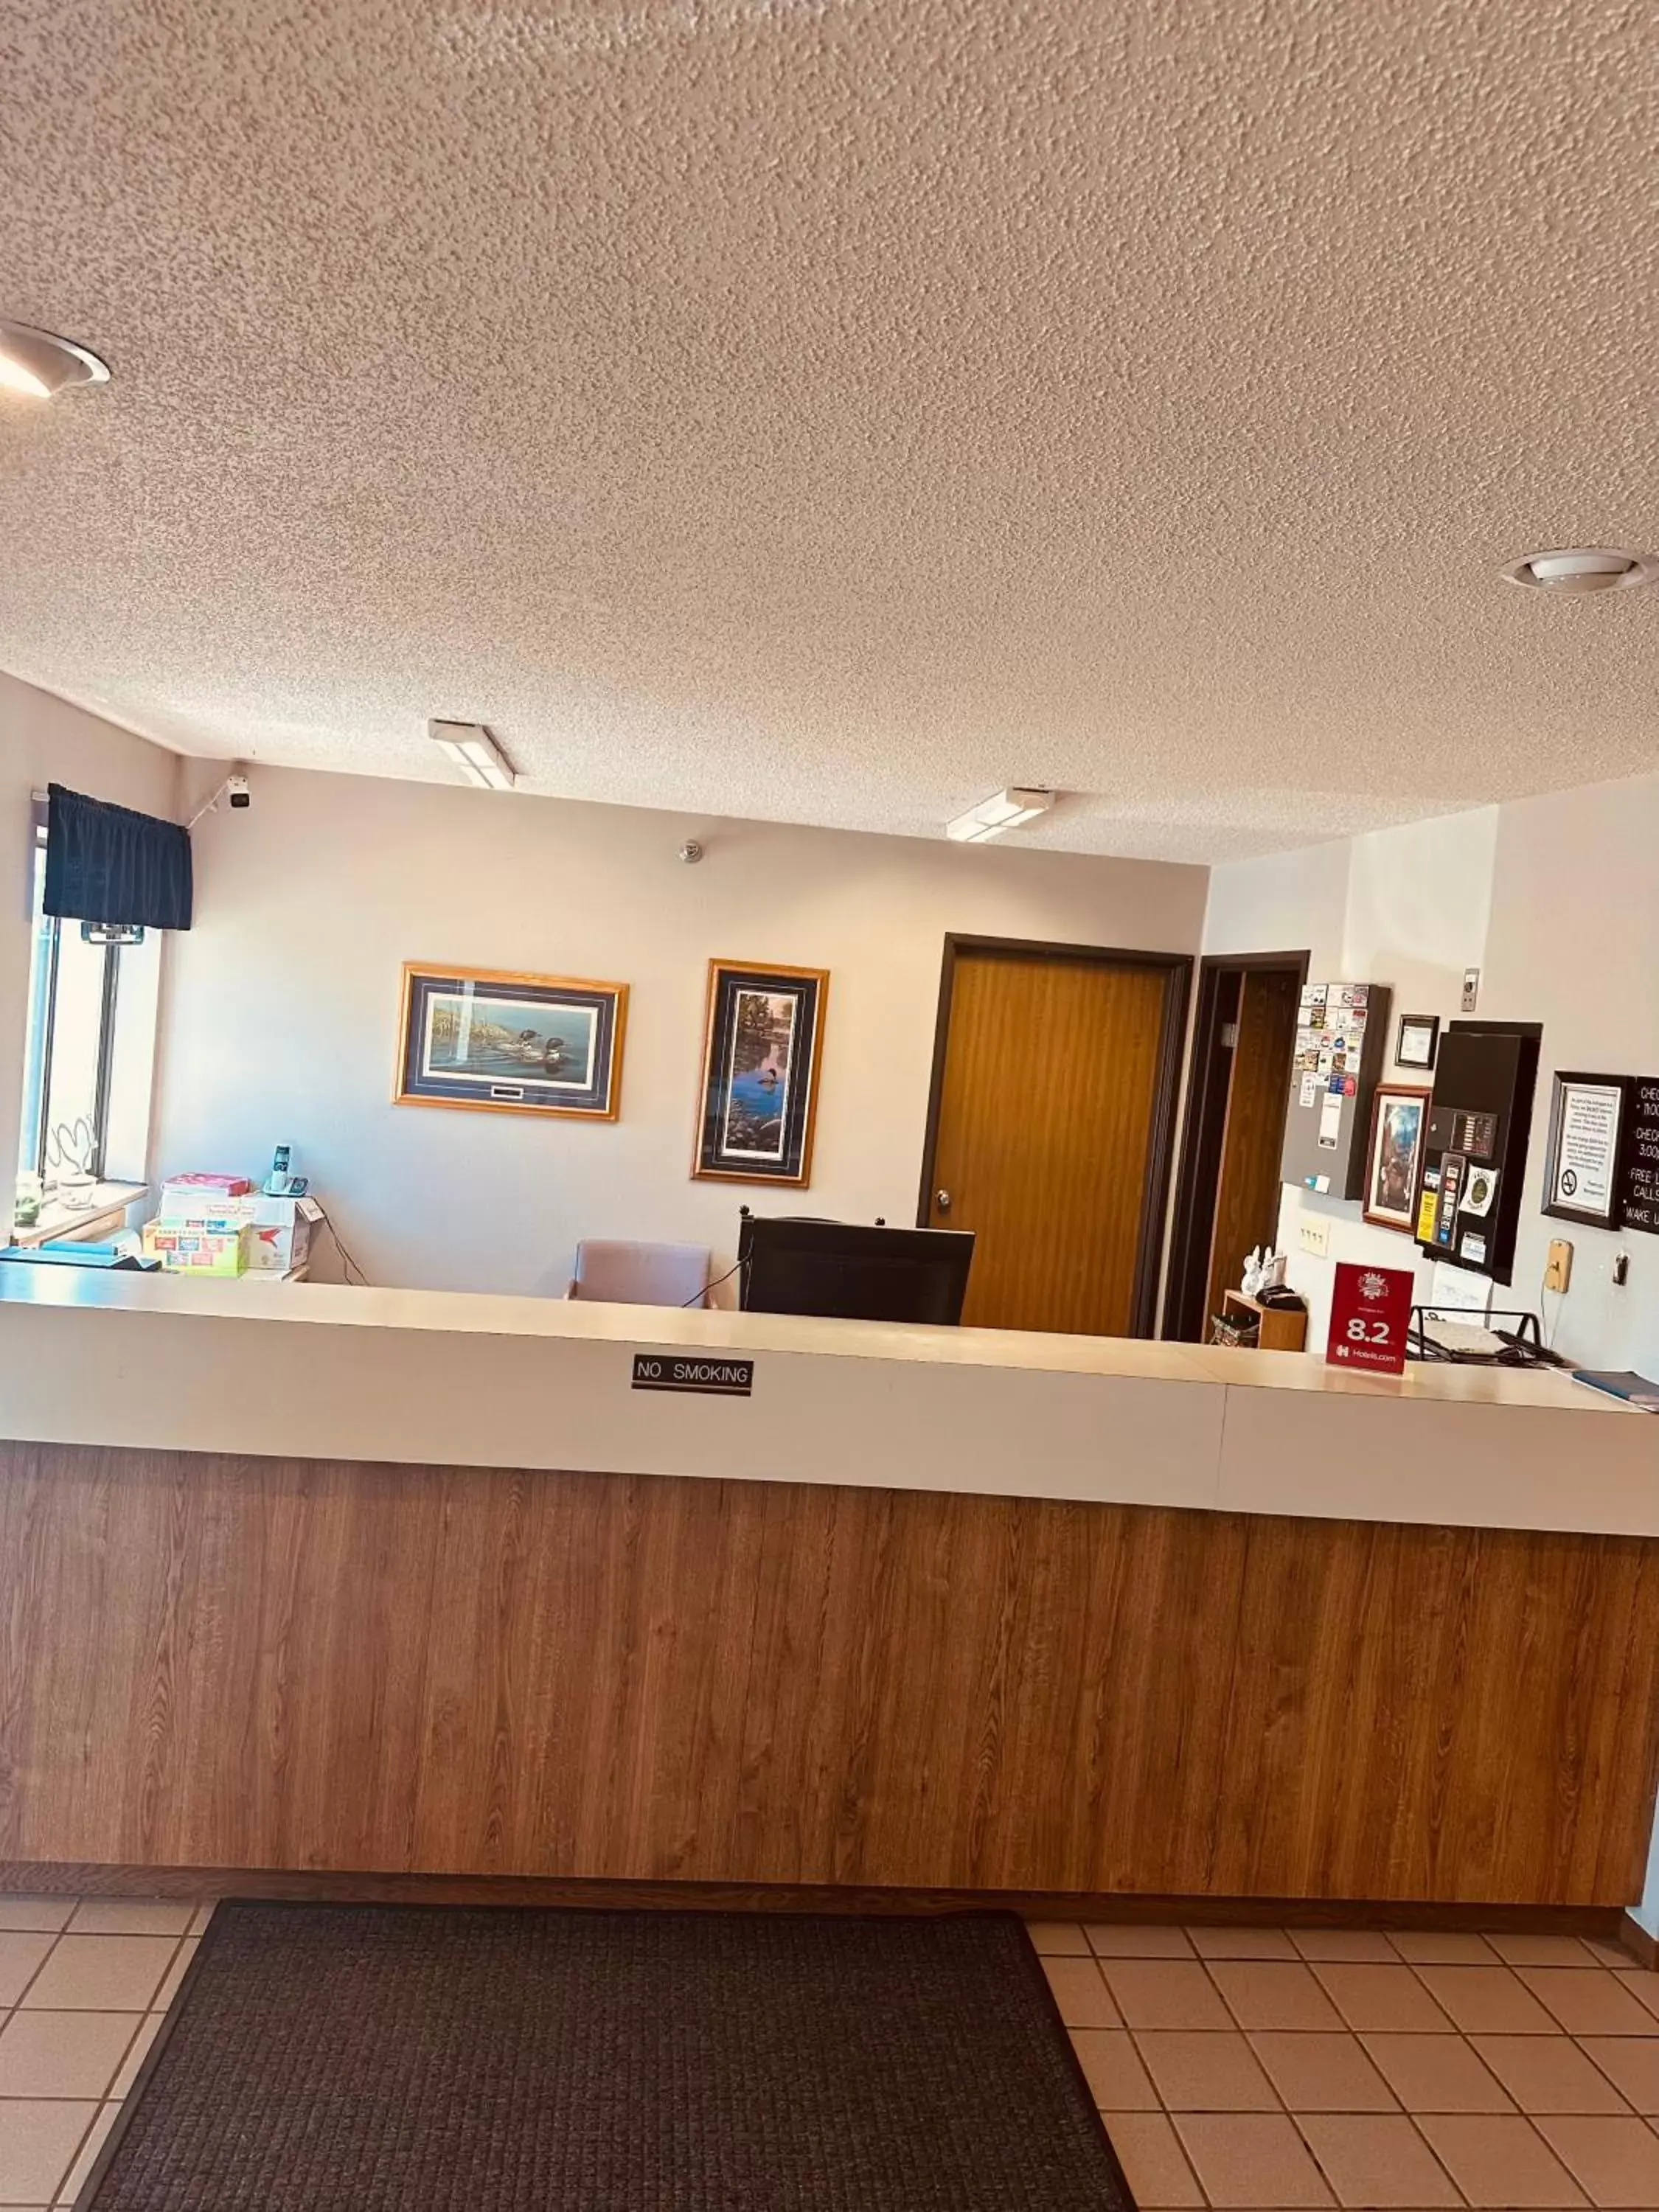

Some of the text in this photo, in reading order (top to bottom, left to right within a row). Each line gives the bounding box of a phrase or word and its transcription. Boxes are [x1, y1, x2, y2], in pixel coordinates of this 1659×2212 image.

[1630, 1167, 1652, 1183] FREE
[1626, 1206, 1650, 1223] WAKE
[1346, 1318, 1390, 1344] 8.2
[1352, 1347, 1397, 1363] Hotels.com
[637, 1361, 748, 1383] NO SMOKING
